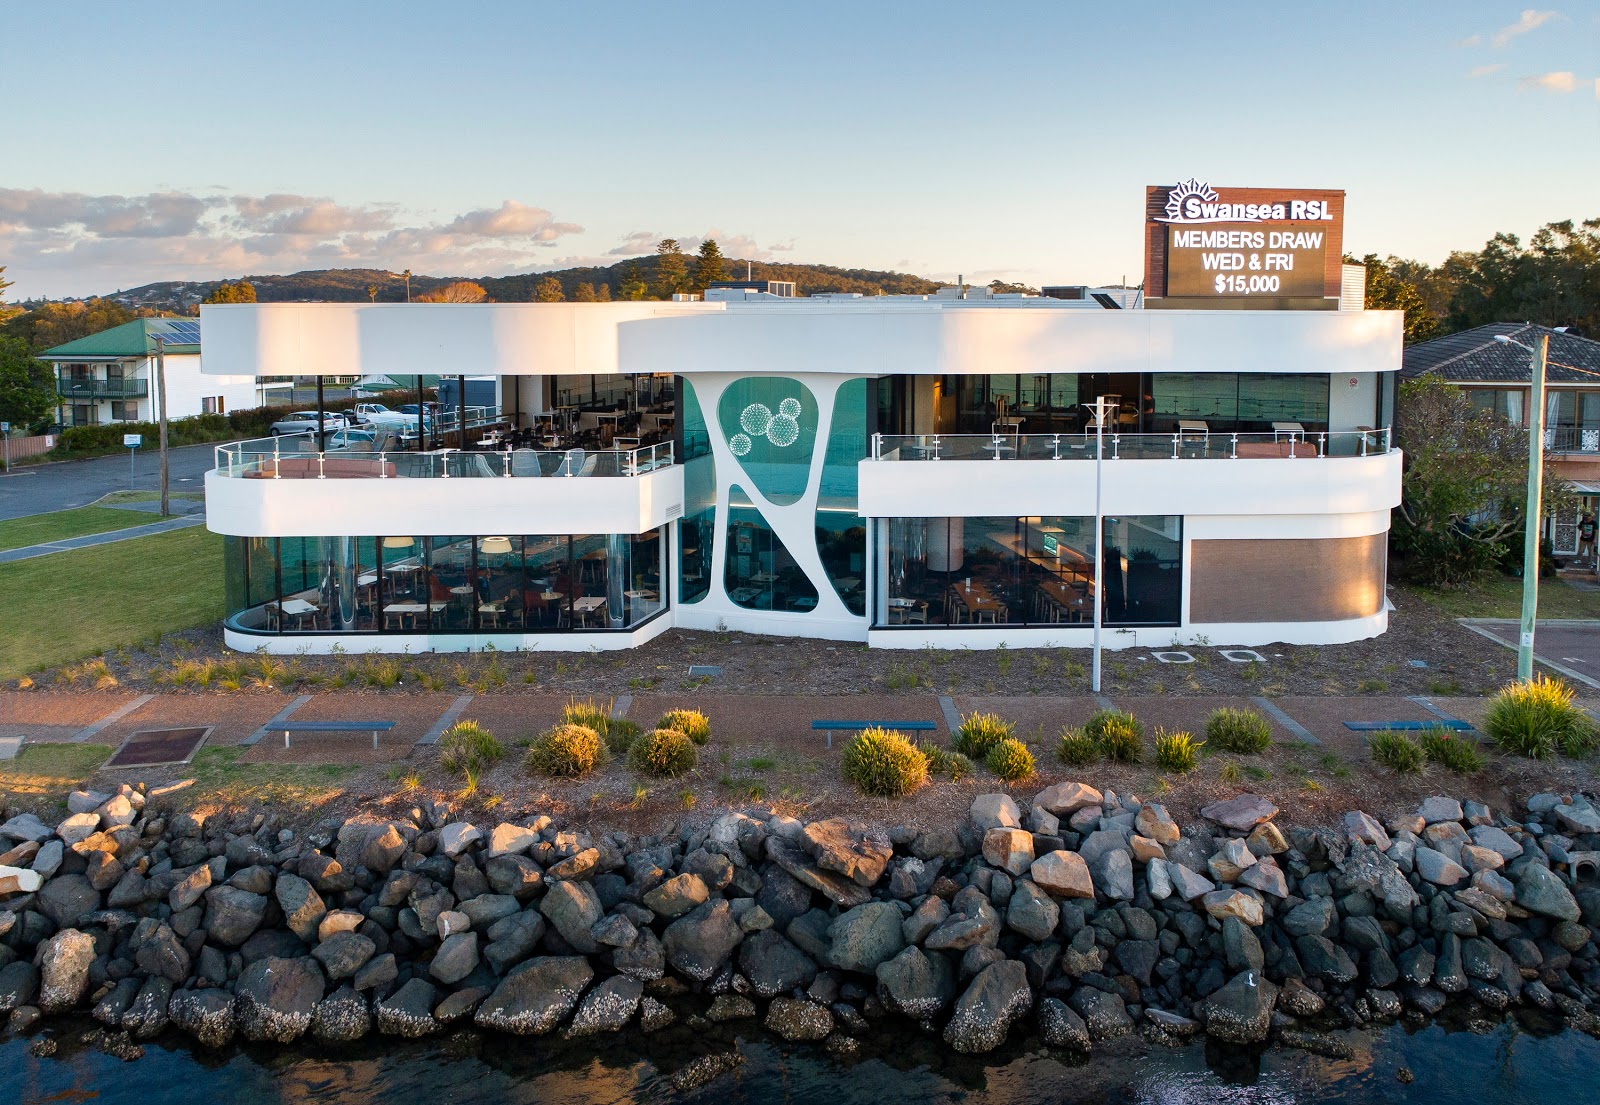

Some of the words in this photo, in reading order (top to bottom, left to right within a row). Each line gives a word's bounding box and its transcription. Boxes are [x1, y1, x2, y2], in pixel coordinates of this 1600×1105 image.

[1185, 198, 1286, 220] Swansea
[1291, 200, 1334, 220] RSL
[1174, 231, 1265, 248] MEMBERS
[1269, 232, 1323, 249] DRAW
[1202, 253, 1245, 270] WED
[1249, 253, 1262, 270] &
[1265, 254, 1294, 271] FRI
[1215, 274, 1280, 294] $15,000
